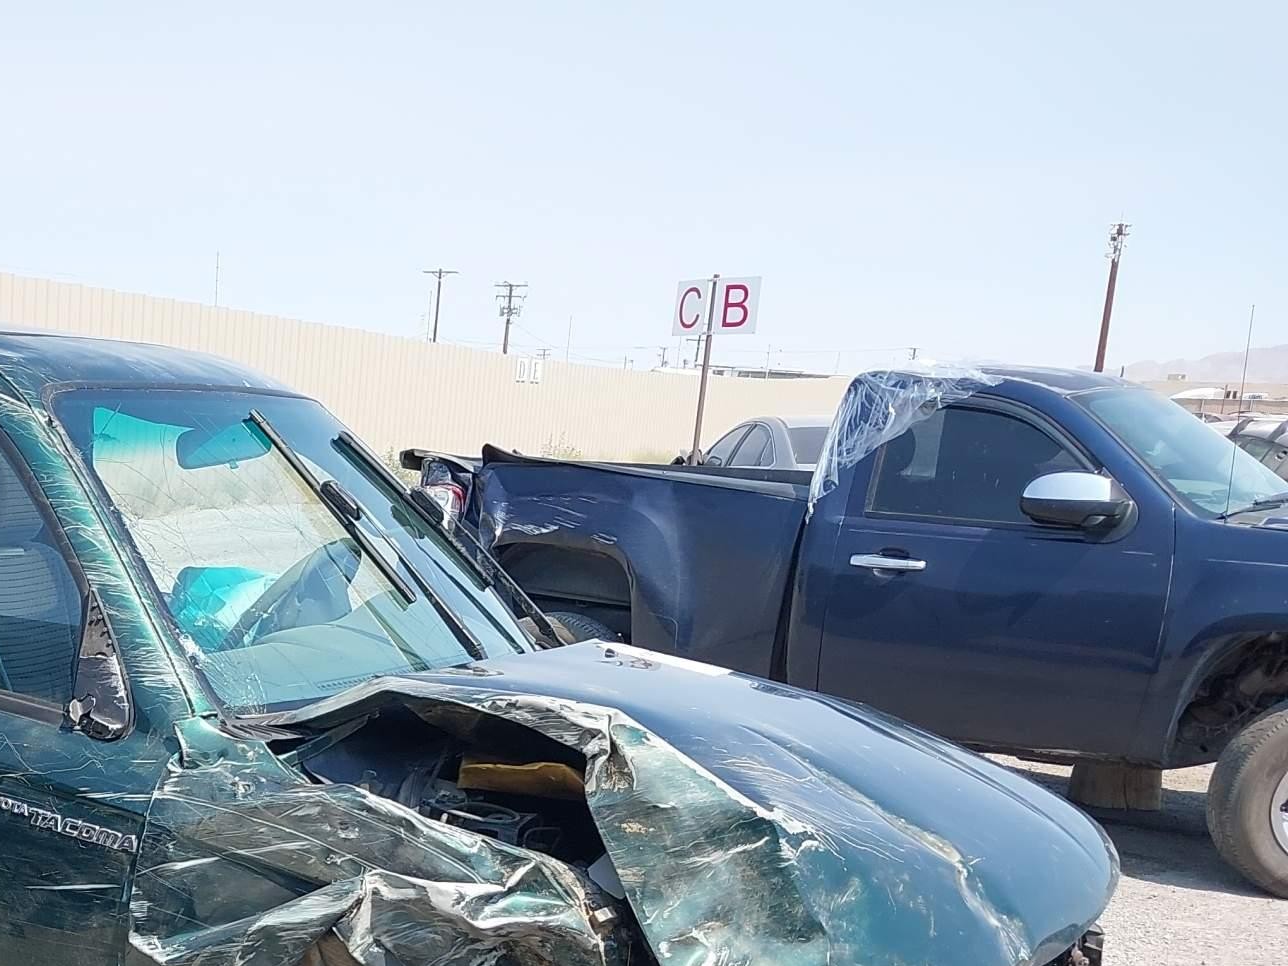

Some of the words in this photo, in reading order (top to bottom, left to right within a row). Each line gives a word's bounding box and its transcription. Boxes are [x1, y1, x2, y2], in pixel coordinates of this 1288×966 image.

[679, 286, 702, 329] C
[721, 284, 749, 328] B
[29, 807, 138, 853] TACOMA
